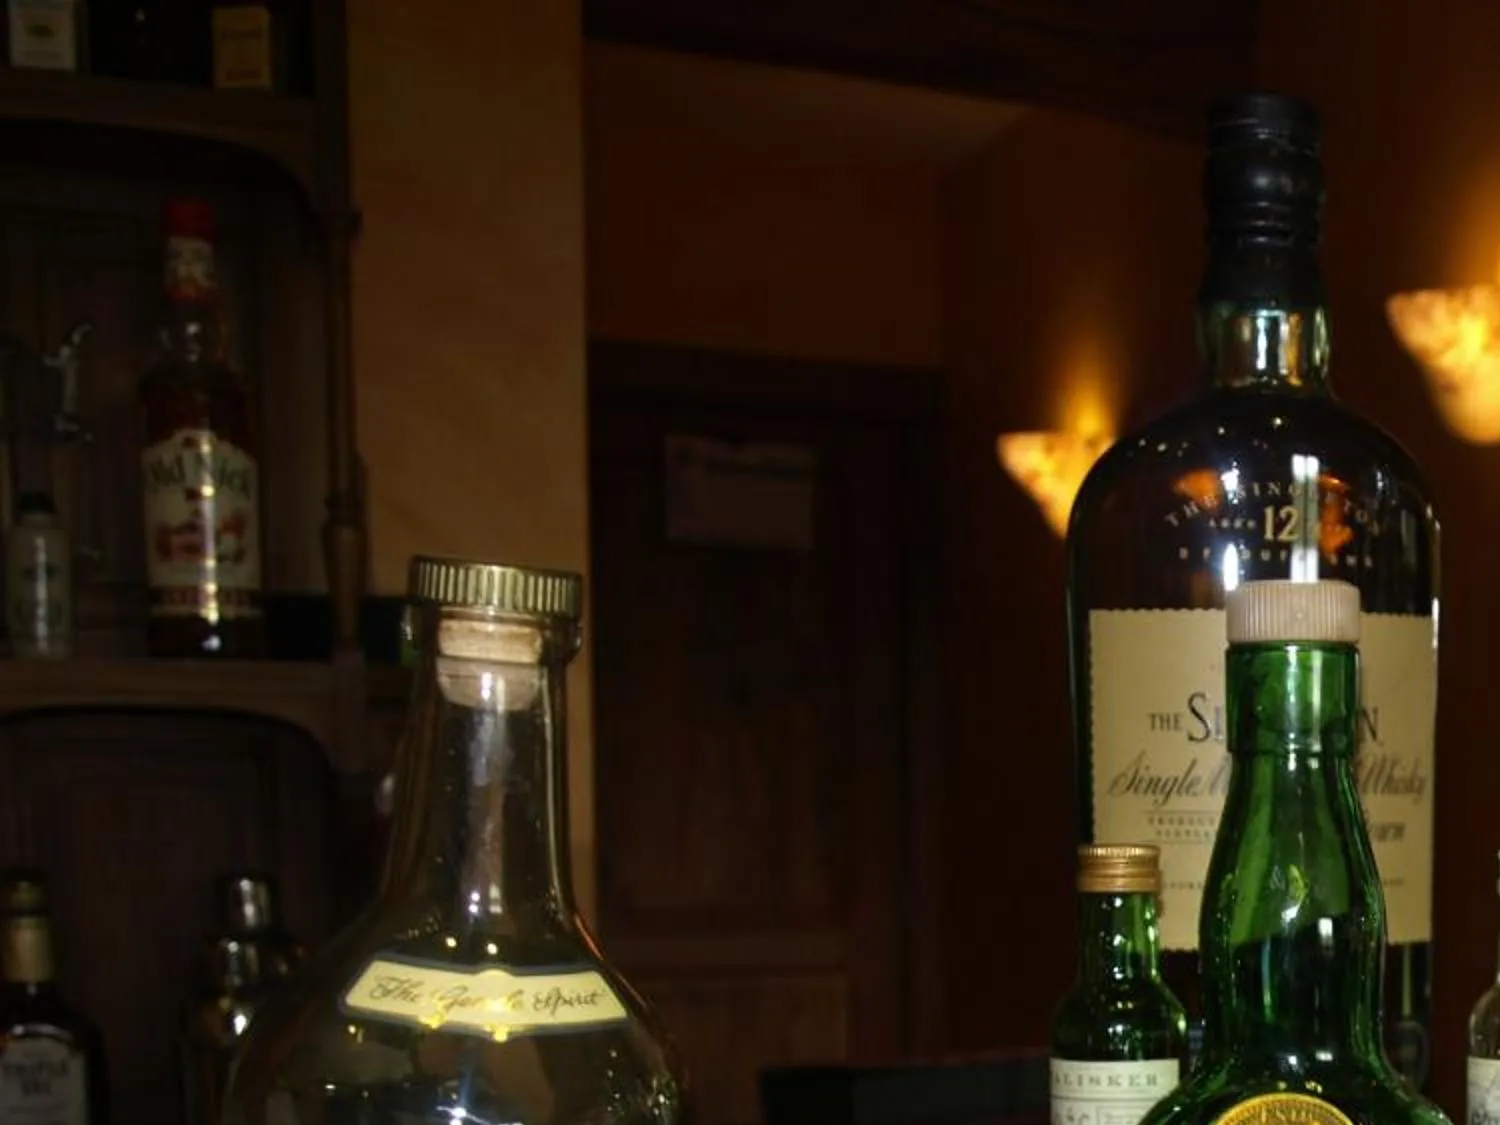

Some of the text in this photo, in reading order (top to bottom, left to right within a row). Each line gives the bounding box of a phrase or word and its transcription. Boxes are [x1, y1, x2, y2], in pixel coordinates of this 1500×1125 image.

[1237, 479, 1382, 537] SINGETON
[1263, 505, 1300, 542] 12
[1148, 712, 1184, 733] THE
[1108, 750, 1203, 807] Single
